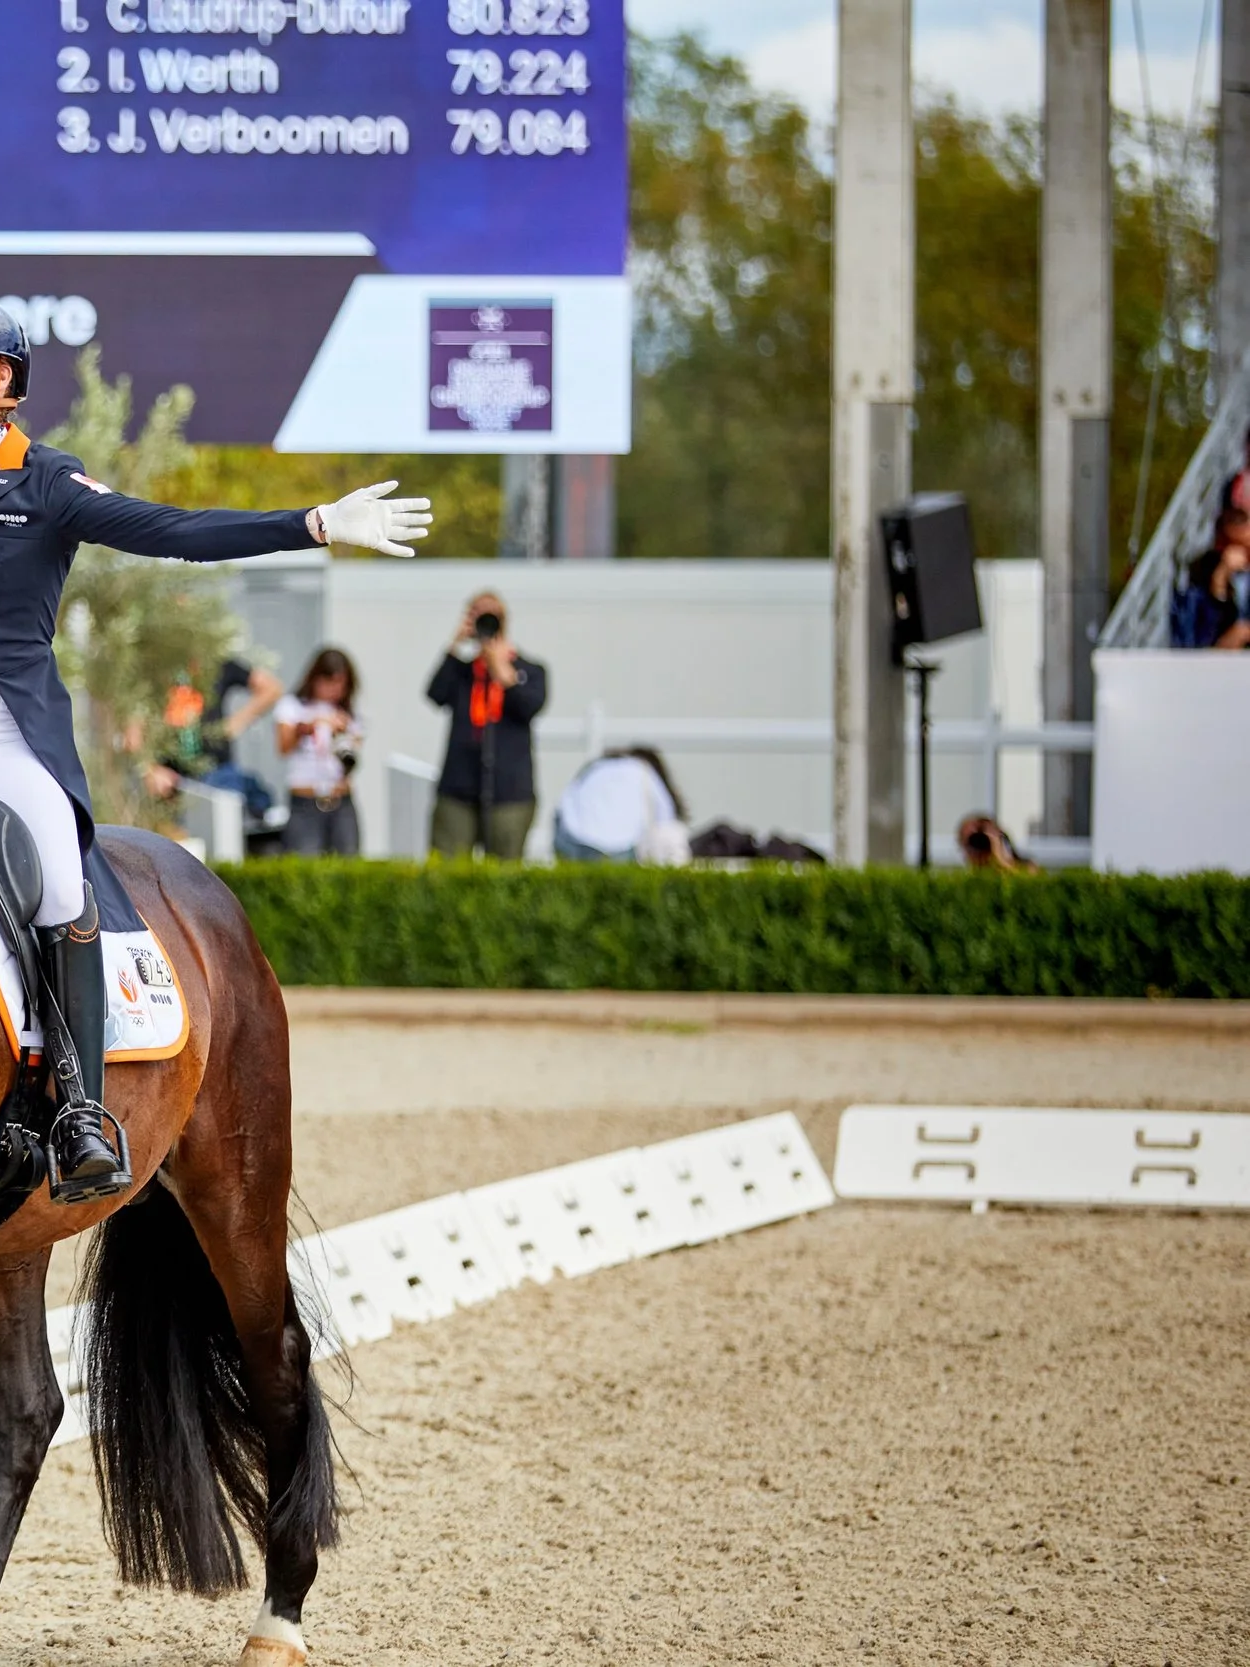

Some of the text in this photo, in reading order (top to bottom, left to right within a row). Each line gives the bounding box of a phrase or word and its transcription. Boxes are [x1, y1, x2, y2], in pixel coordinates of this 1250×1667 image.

[57, 46, 99, 94] 2.
[139, 47, 279, 94] Werth
[447, 48, 590, 95] 79.224
[57, 106, 100, 154] 3.
[107, 107, 147, 154] J.
[150, 106, 409, 154] Verboomen
